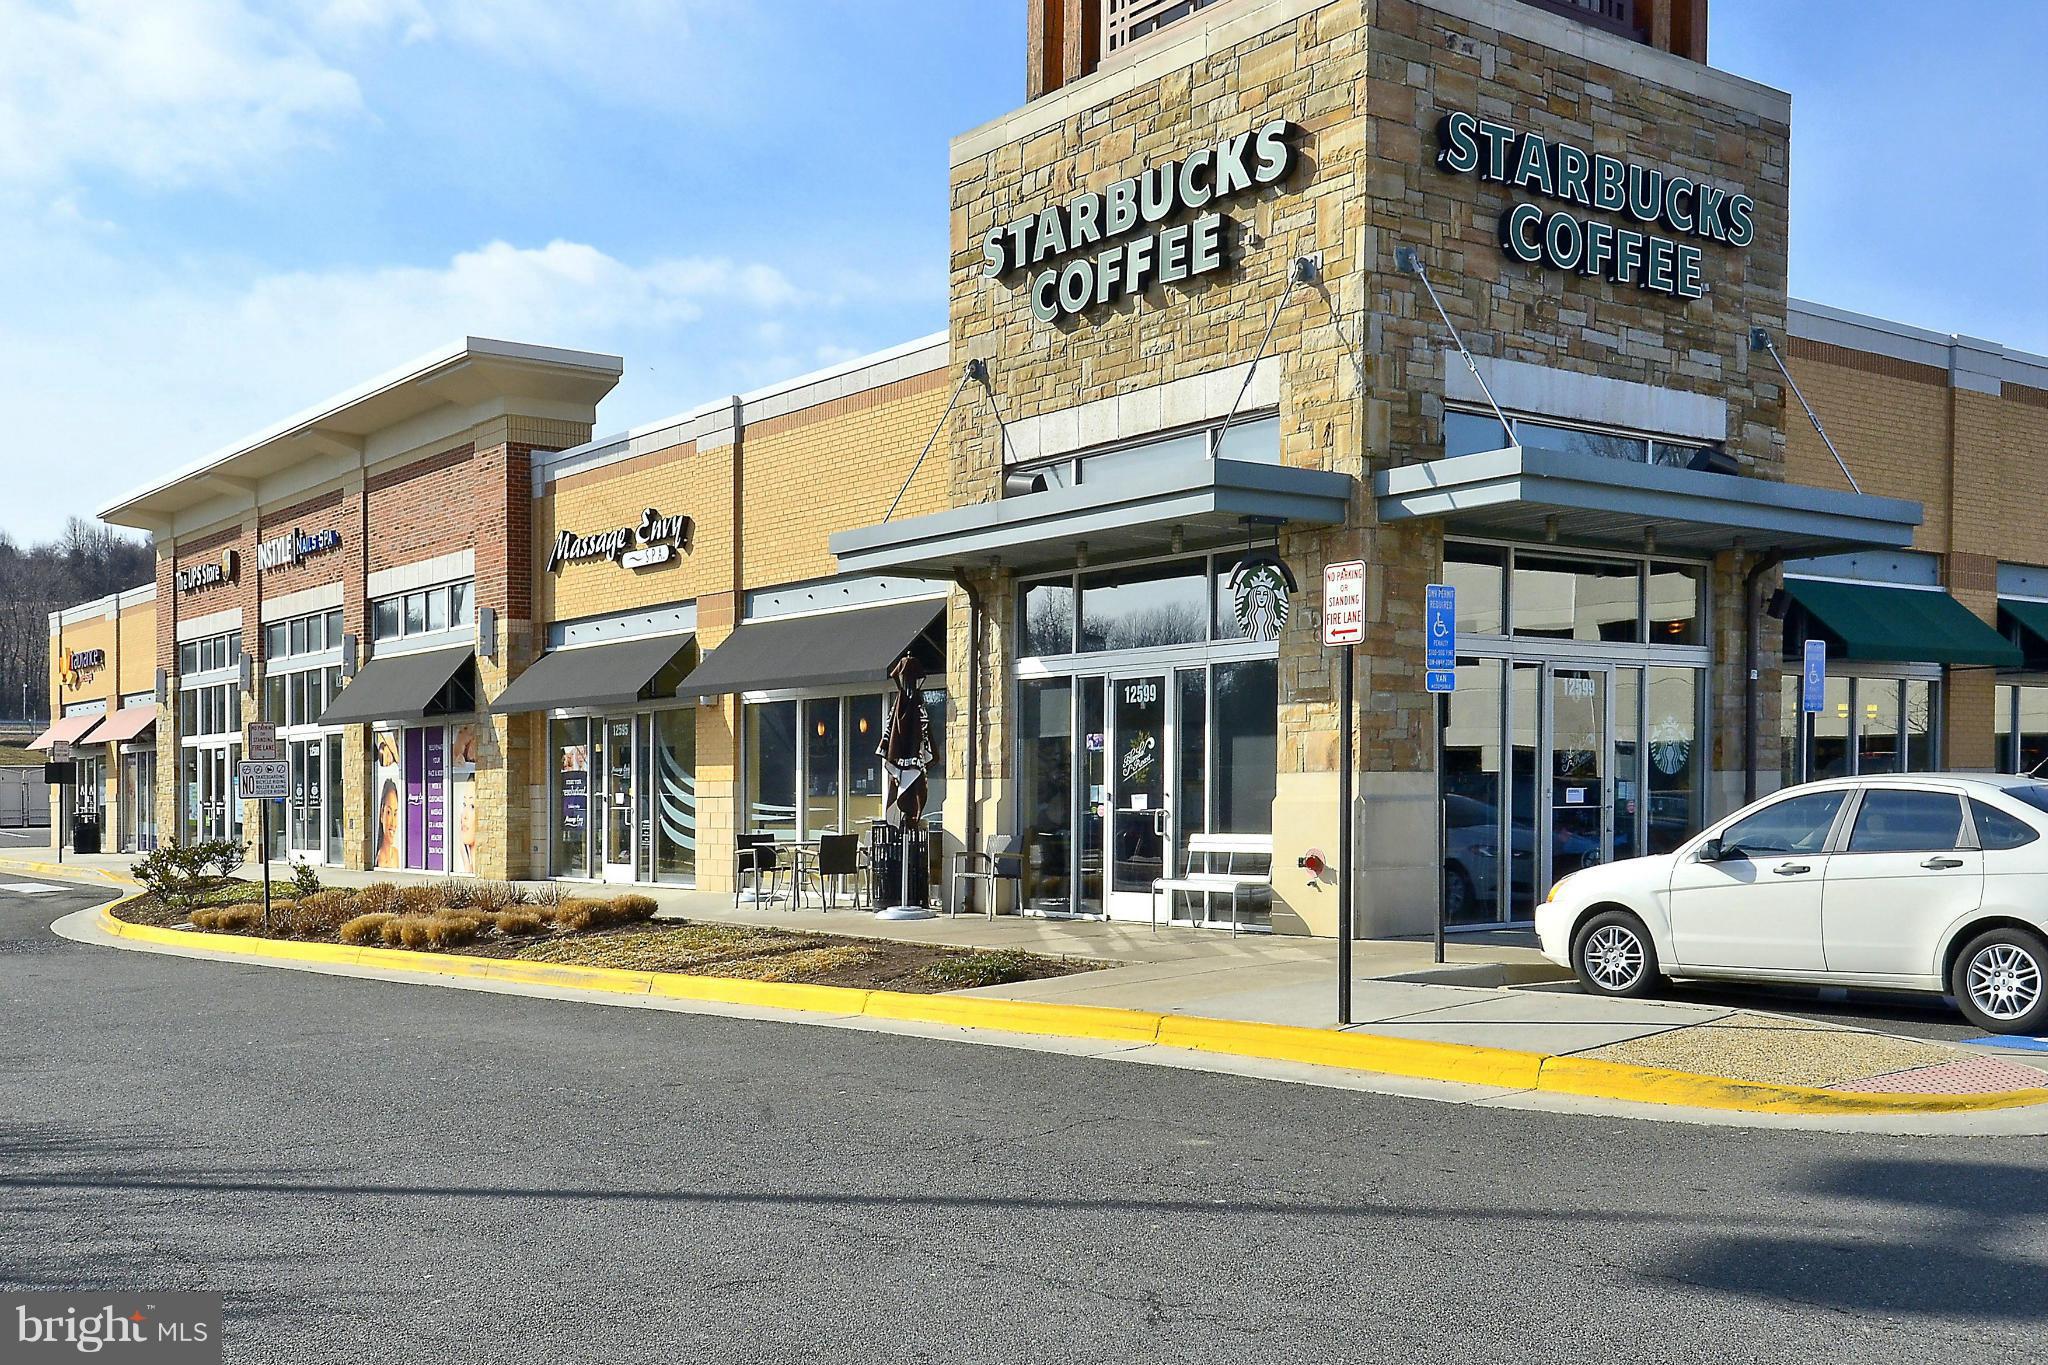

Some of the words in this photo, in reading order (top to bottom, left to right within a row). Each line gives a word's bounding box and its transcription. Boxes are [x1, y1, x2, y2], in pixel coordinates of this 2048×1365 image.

[1447, 111, 1755, 247] STARBUCKS
[982, 119, 1288, 279] STARBUCKS
[1508, 203, 1702, 299] COFFEE
[1031, 212, 1221, 323] COFFEE
[546, 527, 627, 573] Massage
[635, 507, 684, 549] Envy
[258, 533, 293, 571] INSTYLE
[296, 534, 318, 556] NAILS
[318, 529, 332, 548] SPA
[645, 547, 664, 563] SPA
[176, 571, 188, 592] The
[188, 566, 202, 590] UPS
[202, 563, 220, 585] Store
[1327, 572, 1336, 582] NO
[1336, 569, 1362, 581] PARKING
[1339, 584, 1349, 592] OR
[1328, 594, 1360, 608] STANDING
[1326, 612, 1342, 626] FIRE
[1343, 610, 1362, 624] LANE
[1435, 674, 1447, 683] VAN
[1564, 678, 1595, 697] 12599
[1124, 684, 1157, 703] 12599
[242, 775, 255, 795] NO
